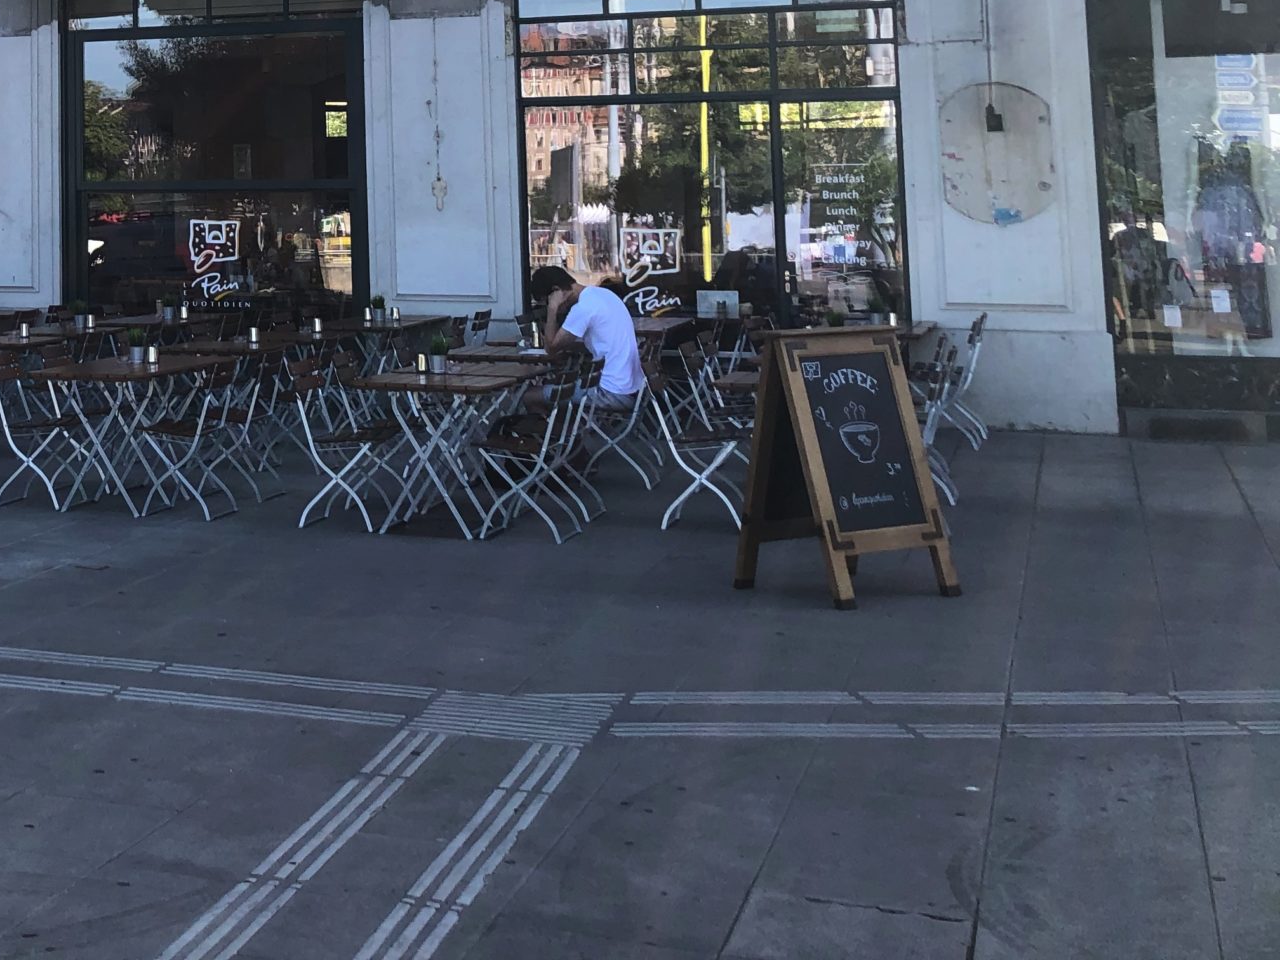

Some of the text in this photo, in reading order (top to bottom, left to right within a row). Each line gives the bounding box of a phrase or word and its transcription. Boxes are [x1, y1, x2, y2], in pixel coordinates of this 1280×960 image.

[815, 173, 865, 184] Breakfast
[822, 190, 860, 200] Brunch
[826, 206, 857, 216] Lunch
[191, 272, 240, 298] Pain
[623, 286, 682, 315] Pain
[823, 367, 878, 394] COFFEE
